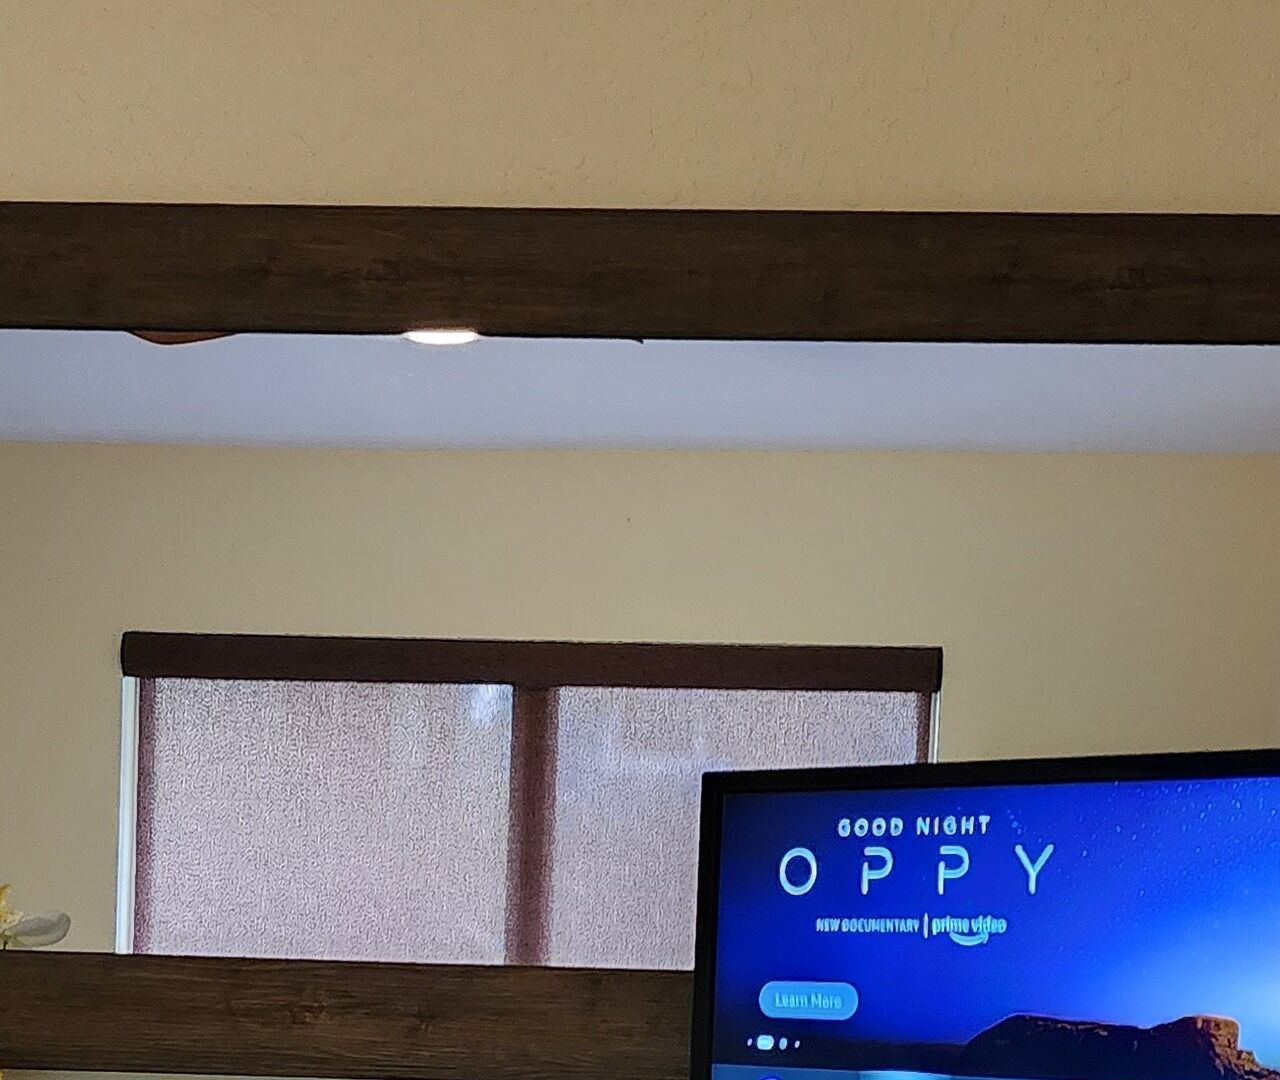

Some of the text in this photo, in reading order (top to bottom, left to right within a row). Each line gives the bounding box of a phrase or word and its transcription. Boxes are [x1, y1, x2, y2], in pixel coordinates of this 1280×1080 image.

[838, 815, 991, 837] GOOD NIGHT
[816, 918, 920, 933] NEW DOCUMENTARY
[932, 915, 969, 935] prime
[774, 992, 842, 1009] Learn More
